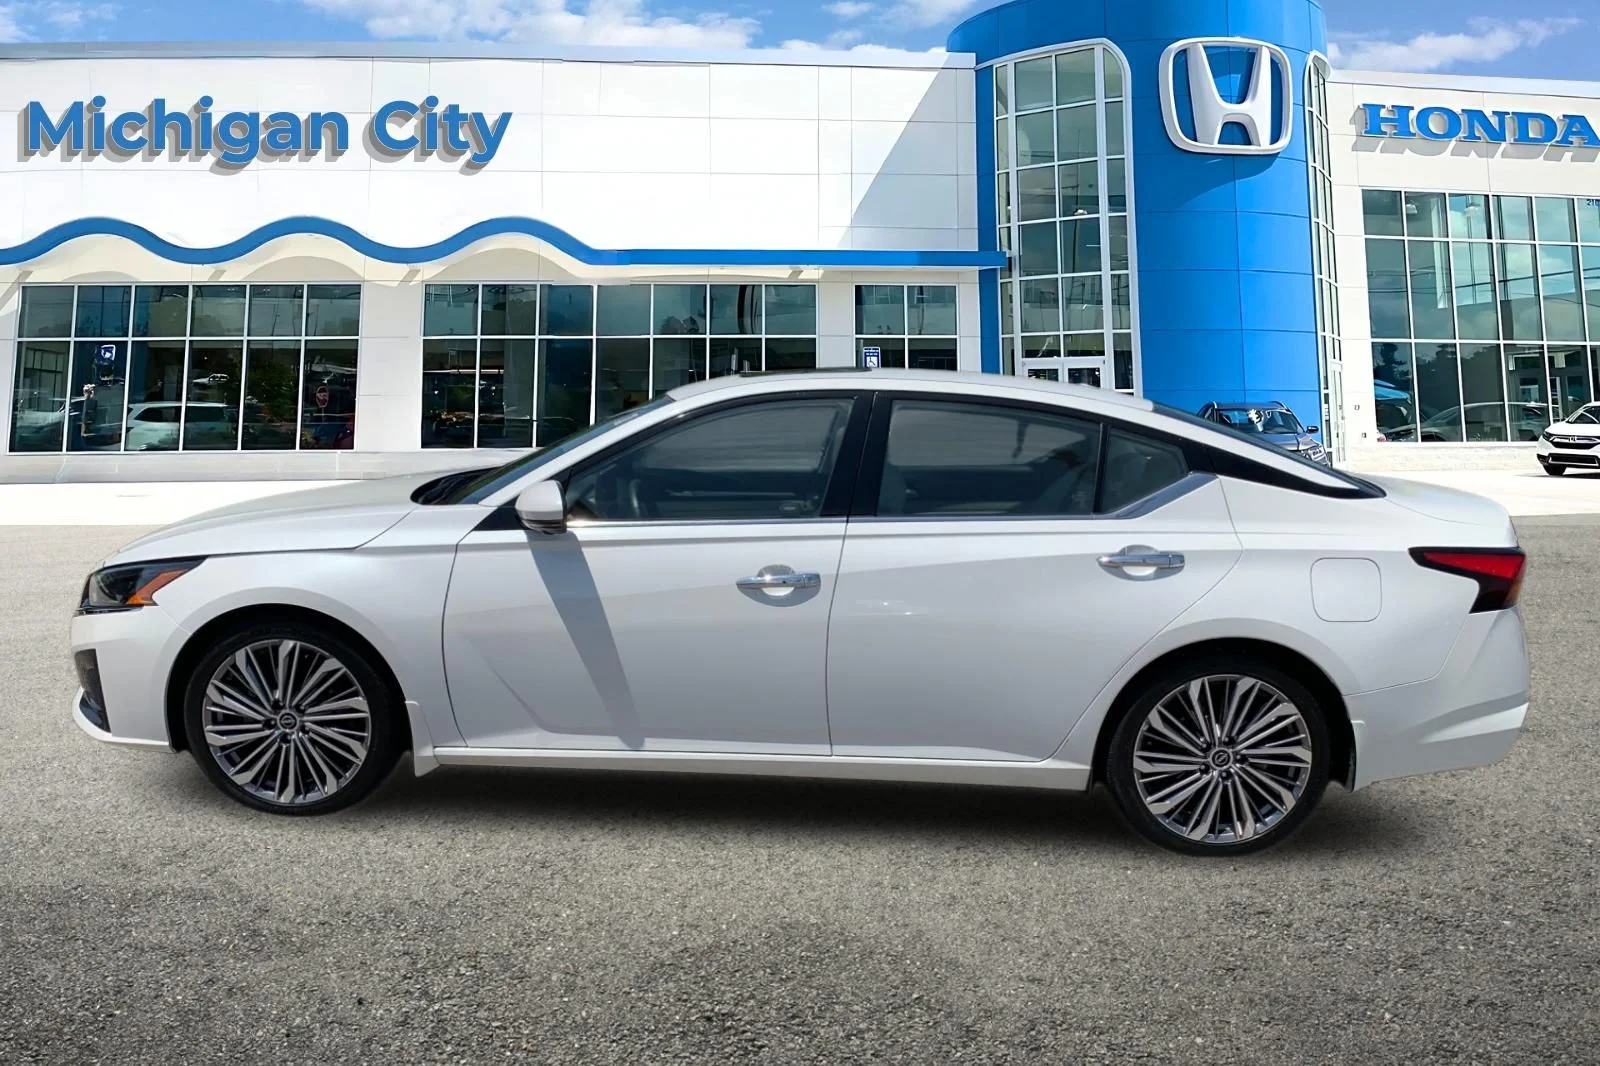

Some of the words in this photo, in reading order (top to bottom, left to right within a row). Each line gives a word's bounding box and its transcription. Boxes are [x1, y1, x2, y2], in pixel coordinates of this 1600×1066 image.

[27, 96, 349, 165] Michigan
[372, 95, 513, 165] City
[1361, 103, 1600, 147] HONDA
